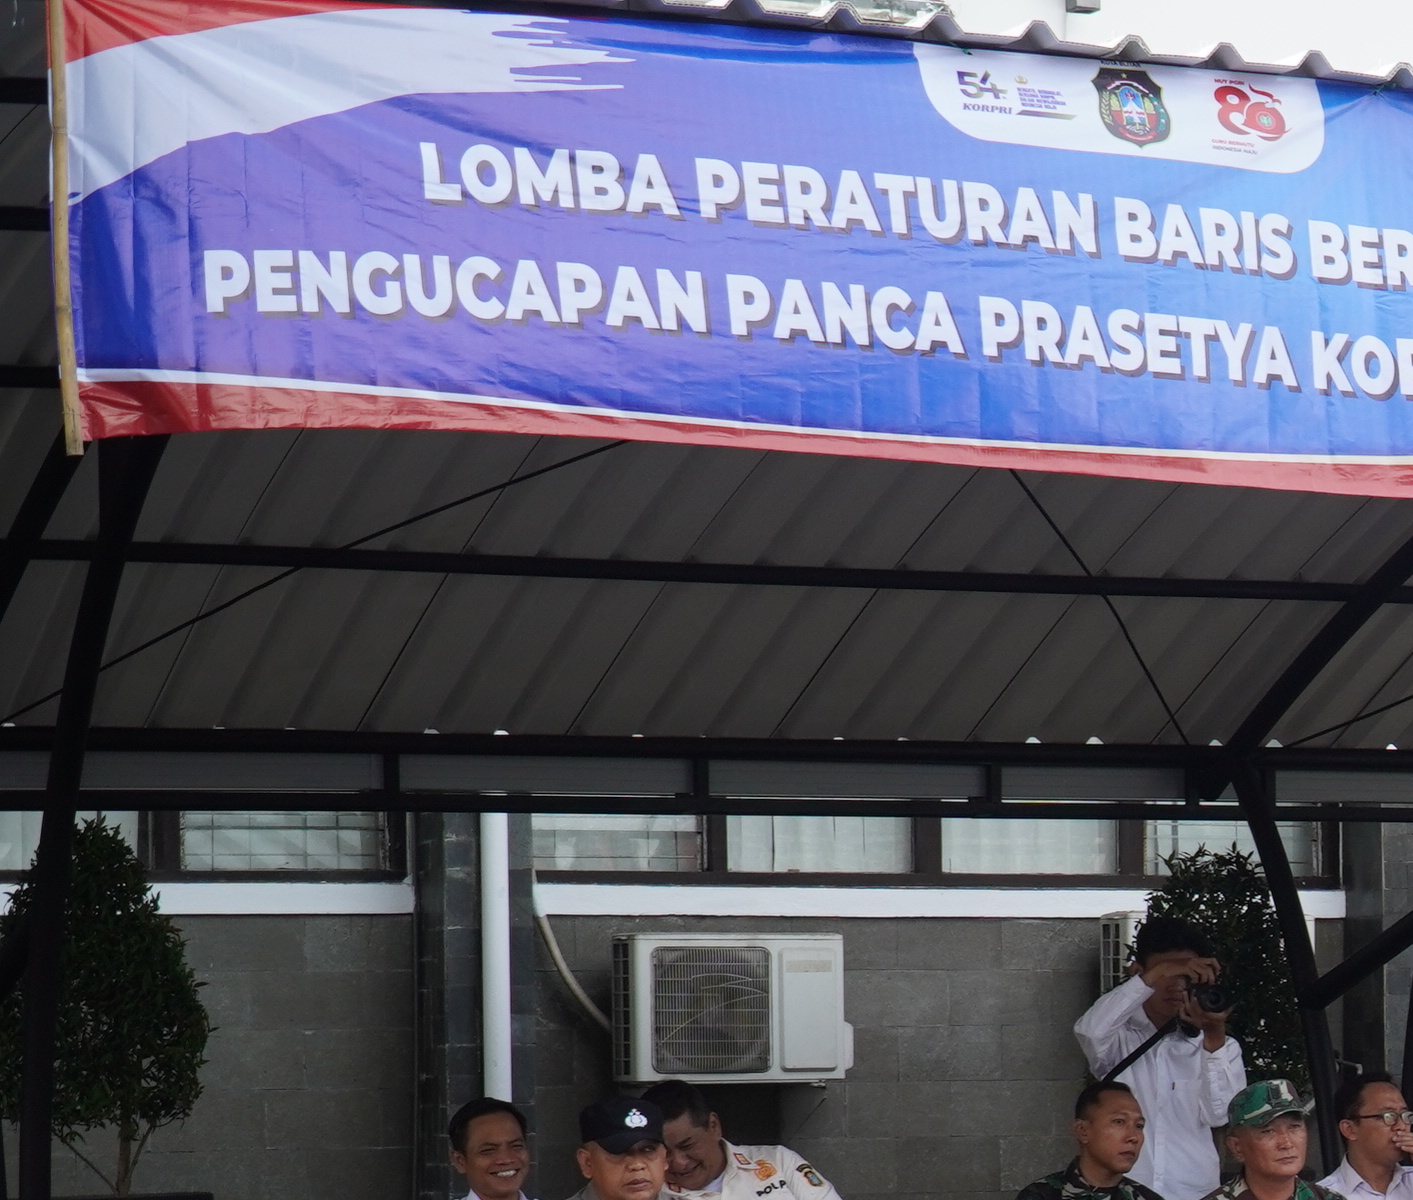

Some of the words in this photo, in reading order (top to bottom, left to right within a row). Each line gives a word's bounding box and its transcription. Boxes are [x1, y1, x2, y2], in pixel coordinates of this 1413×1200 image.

[956, 69, 1008, 100] 54
[963, 103, 1012, 115] KORPRI
[420, 141, 681, 216] LOMBA
[694, 157, 1098, 253] PERATURAN
[1114, 196, 1295, 275] BARIS
[203, 249, 708, 333] PENGUCAPAN
[726, 273, 965, 355] PANCA
[979, 295, 1299, 388] PRASETYA
